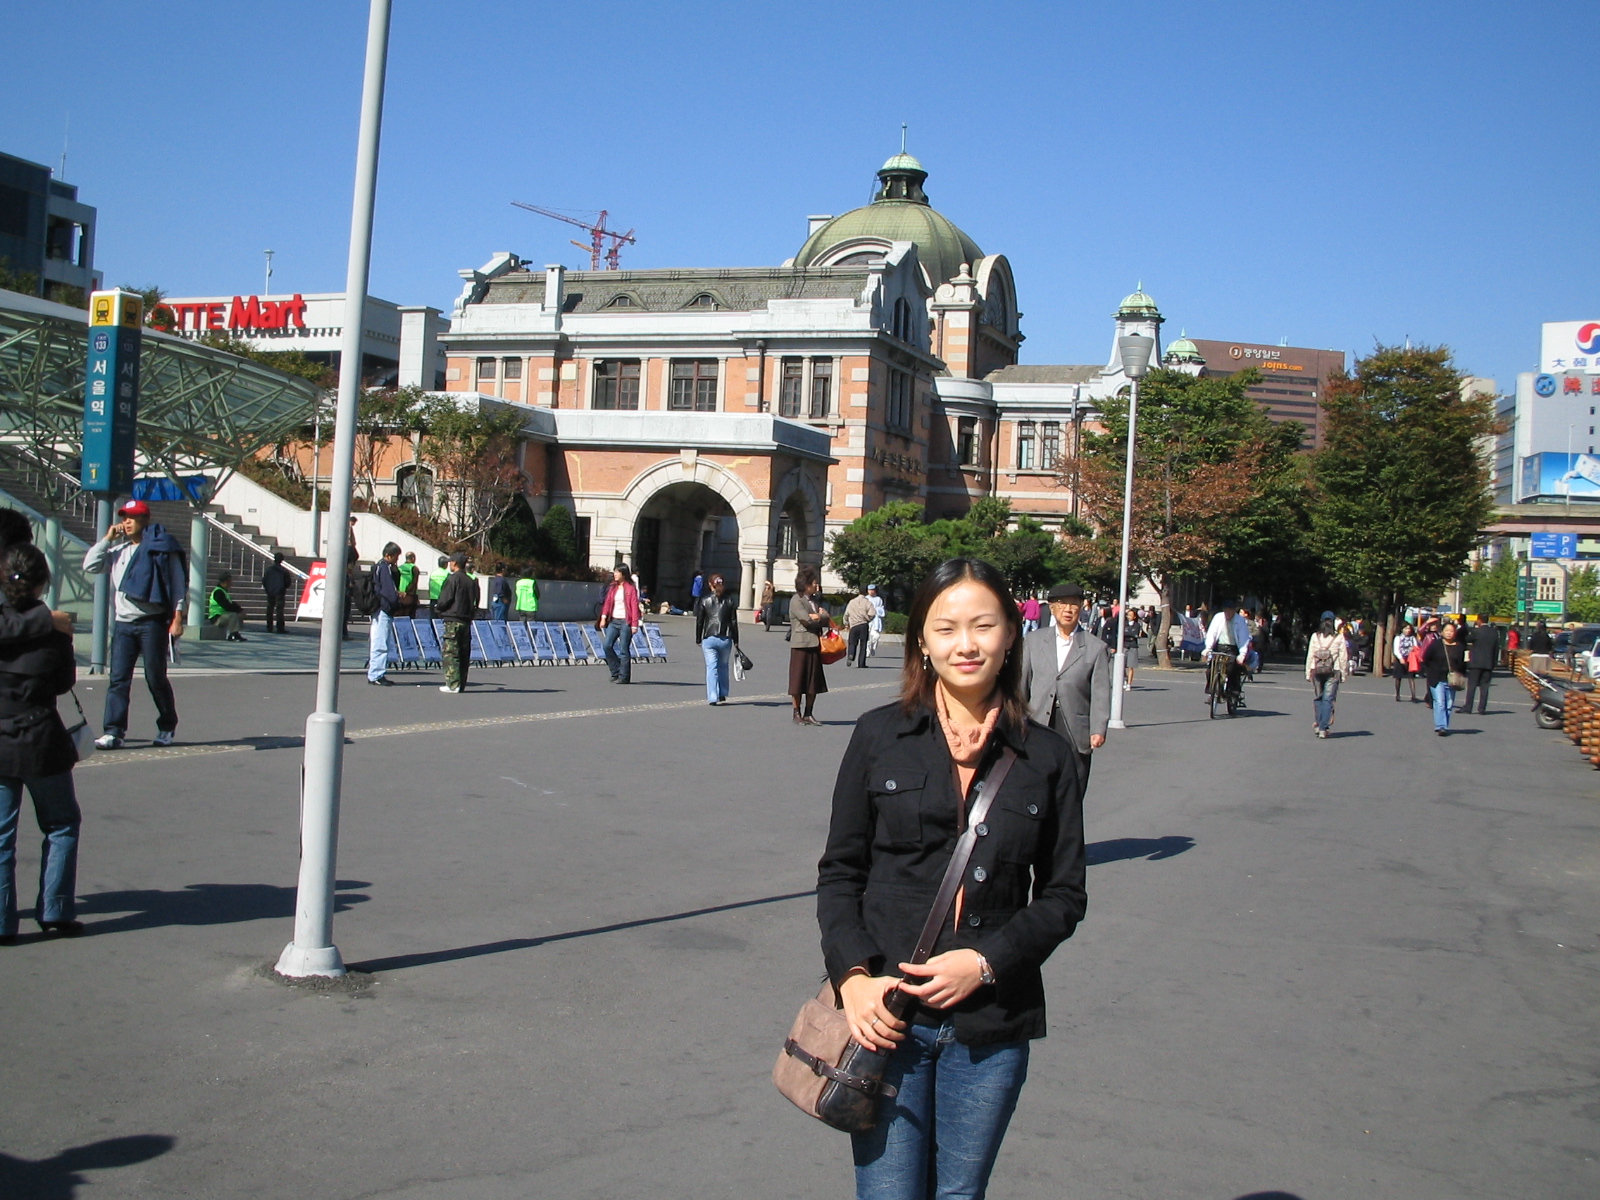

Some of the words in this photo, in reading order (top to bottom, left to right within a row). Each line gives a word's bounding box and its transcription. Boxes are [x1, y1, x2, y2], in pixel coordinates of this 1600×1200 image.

[151, 302, 224, 331] OTTE
[228, 294, 305, 329] Mart
[95, 341, 107, 350] 133
[1243, 347, 1281, 360] 중앙일보
[91, 360, 107, 416] 서울역
[90, 468, 97, 480] 1
[1561, 535, 1571, 546] P
